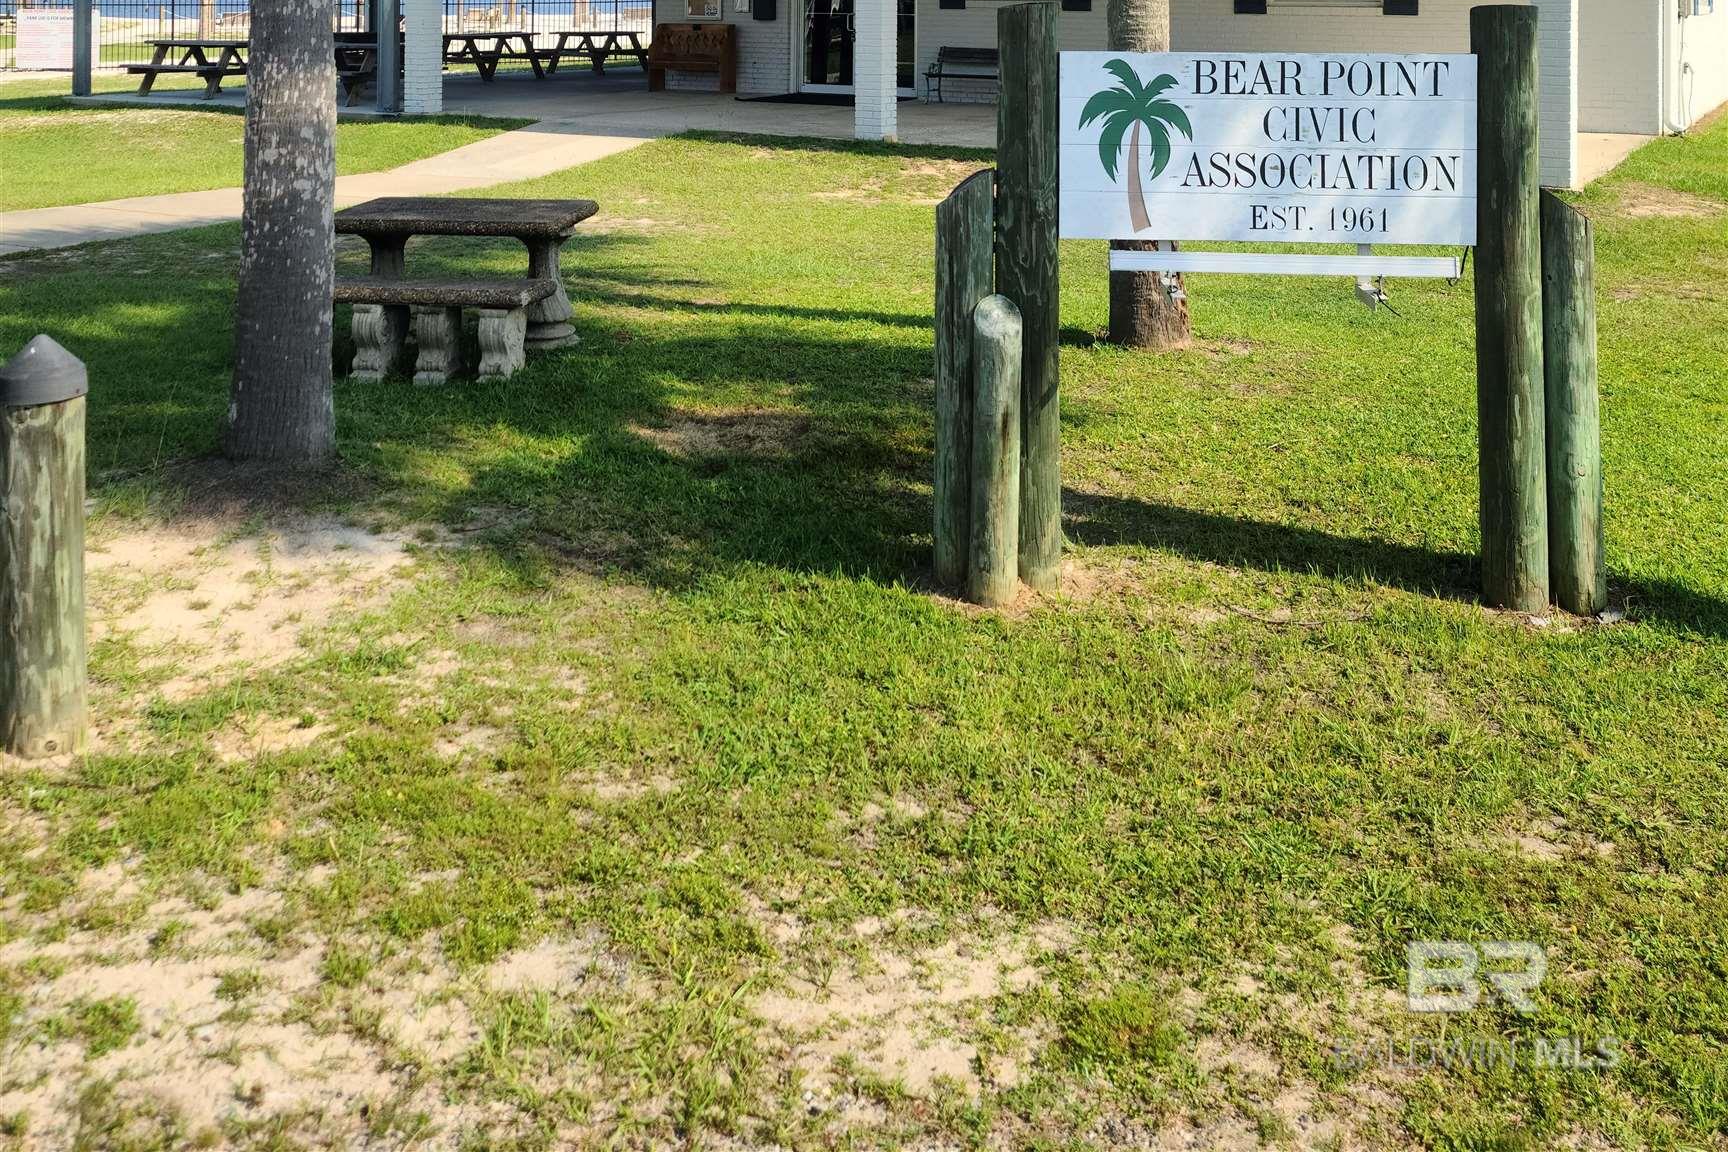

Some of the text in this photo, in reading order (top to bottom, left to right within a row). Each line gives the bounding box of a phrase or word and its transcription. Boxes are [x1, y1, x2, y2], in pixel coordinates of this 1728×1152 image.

[1191, 59, 1450, 97] BEAR POINT
[1262, 106, 1376, 143] CIVIC
[1180, 152, 1461, 192] ASSOCIATION
[1249, 204, 1390, 233] EST. 1961
